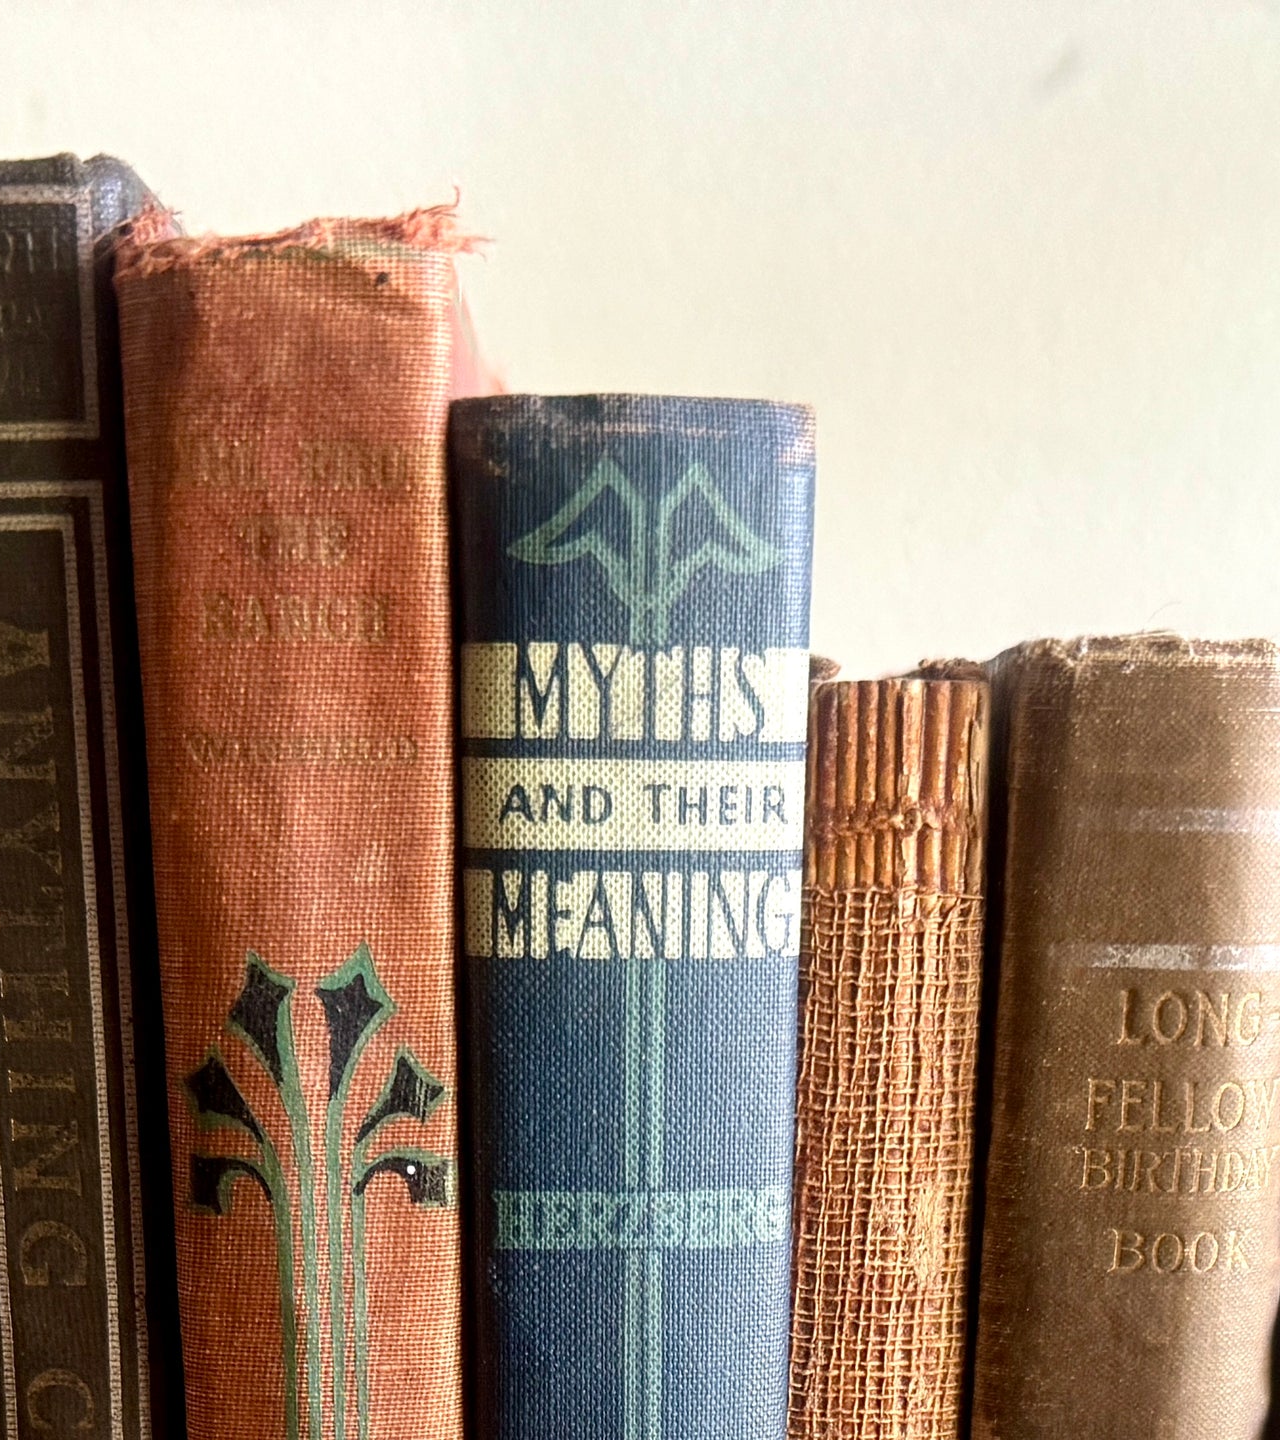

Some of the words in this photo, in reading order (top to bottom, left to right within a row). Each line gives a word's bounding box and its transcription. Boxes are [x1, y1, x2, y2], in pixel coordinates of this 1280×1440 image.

[513, 643, 766, 742] MYTHS
[499, 783, 613, 826] AND
[643, 782, 789, 826] THEIR
[490, 869, 795, 959] MEANING
[495, 1187, 788, 1250] HERZBERG
[1106, 1228, 1254, 1275] BOOK
